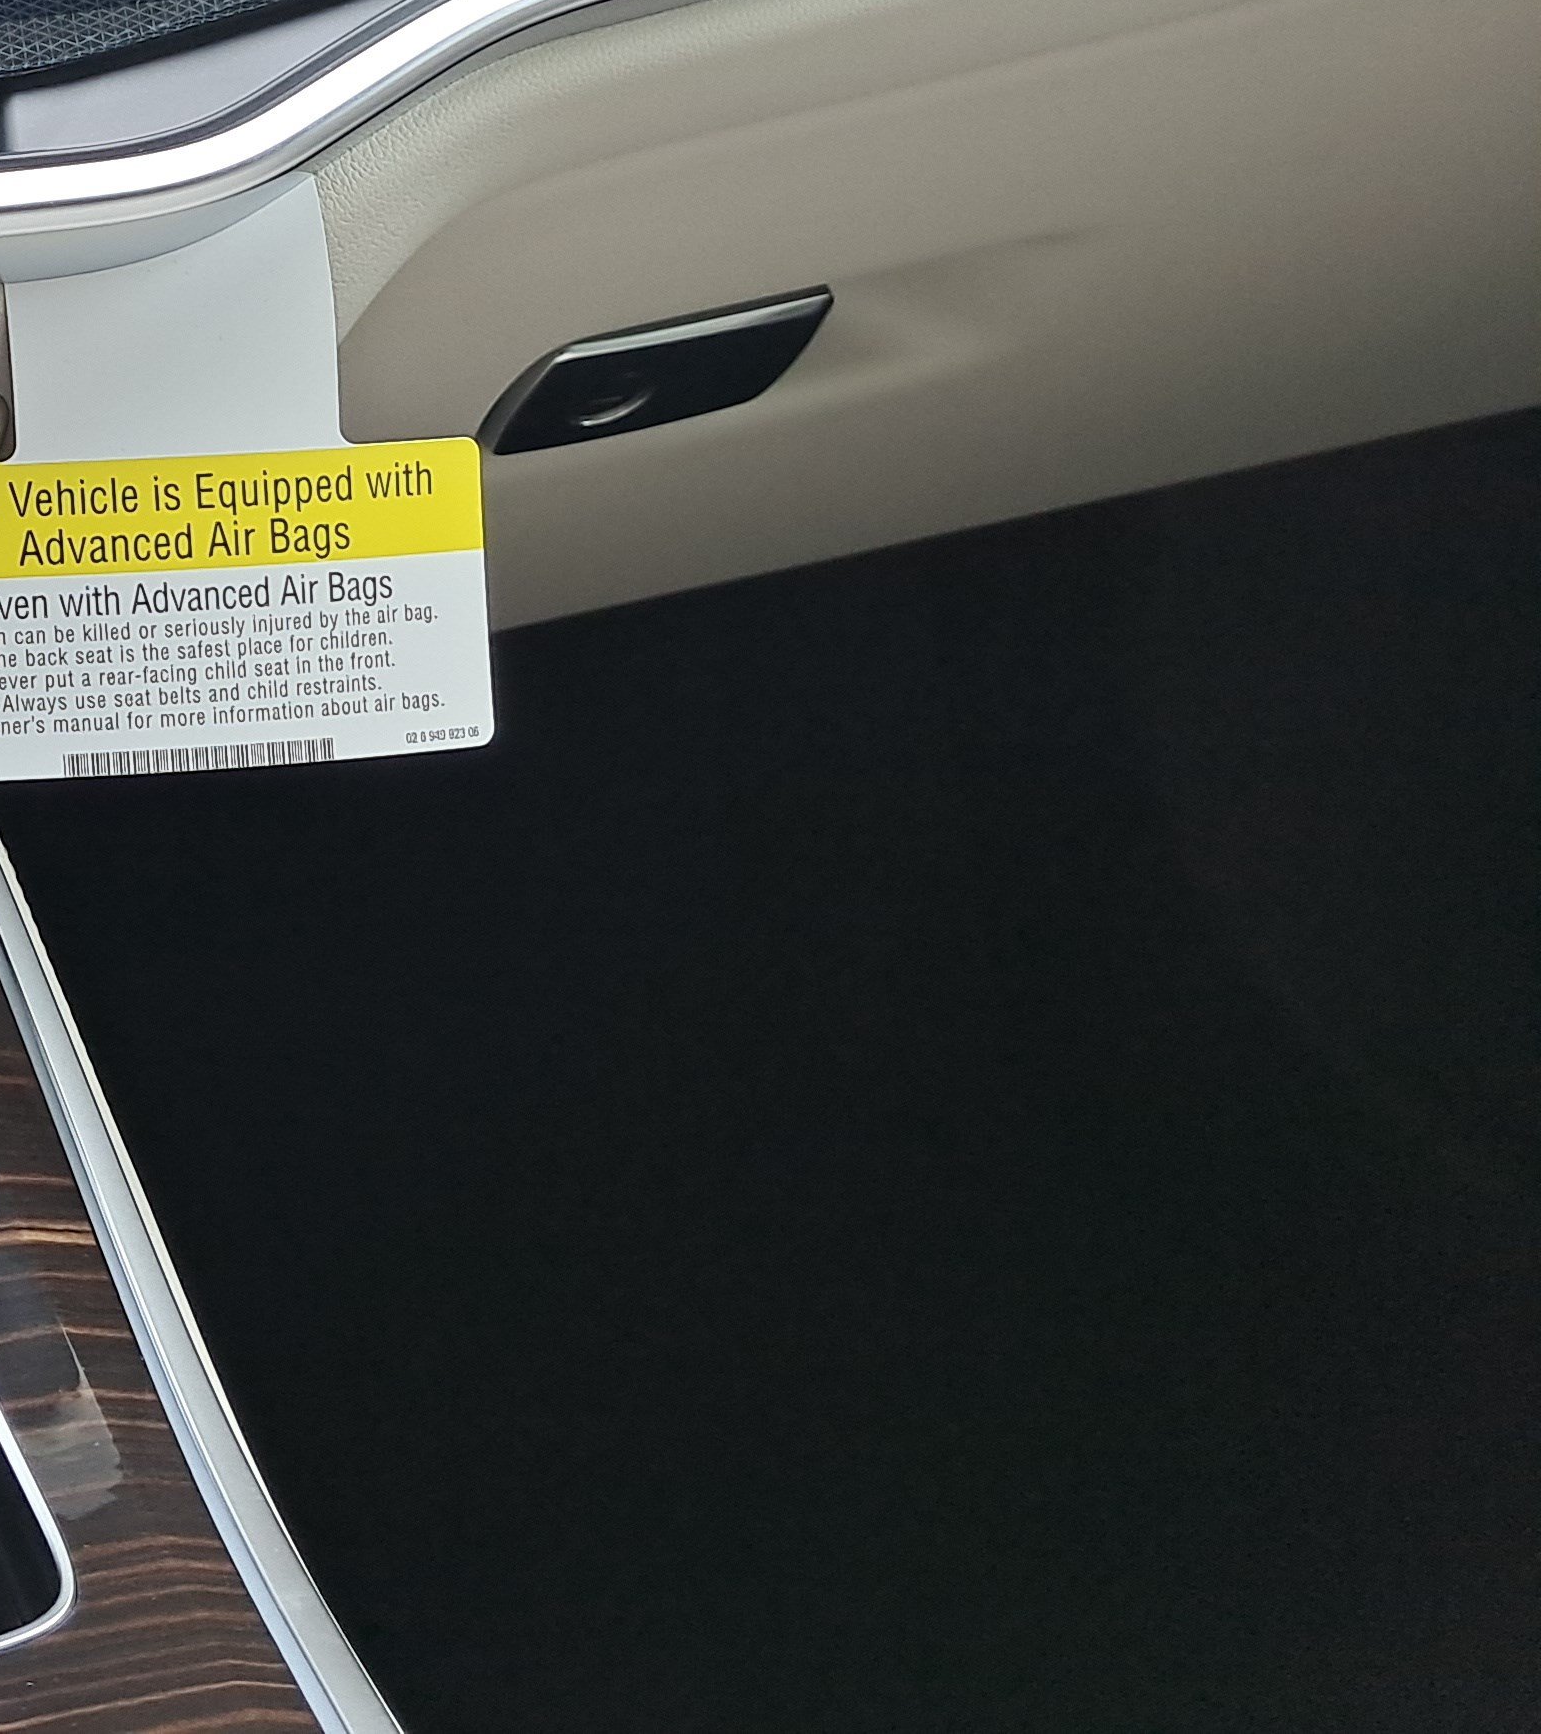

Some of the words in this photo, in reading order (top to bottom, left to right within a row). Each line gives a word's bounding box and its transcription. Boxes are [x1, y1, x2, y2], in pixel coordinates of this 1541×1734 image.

[9, 478, 139, 518] Vehicle
[152, 475, 182, 512] is
[195, 465, 353, 515] Equipped
[365, 460, 434, 499] with
[19, 523, 193, 567] Advanced
[207, 520, 256, 557] Air
[270, 517, 351, 559] Bags
[58, 582, 120, 618] with
[132, 577, 270, 614] Advanced
[281, 574, 318, 606] Air
[328, 570, 393, 608] Bags
[14, 630, 46, 646] can
[54, 625, 75, 643] be
[82, 622, 131, 642] killed
[138, 624, 157, 640] or
[164, 617, 246, 639] seriously
[252, 611, 312, 636] injured
[319, 611, 339, 631] by
[345, 607, 371, 626] the
[377, 604, 398, 623] air
[404, 604, 438, 626] bag.
[25, 648, 69, 667] back
[75, 646, 113, 665] seat
[120, 645, 135, 663] is
[142, 643, 170, 661] the
[177, 640, 231, 660] safest
[237, 637, 283, 659] place
[290, 635, 314, 653] for
[320, 630, 394, 650] children.
[45, 670, 75, 692] put
[81, 672, 92, 687] a
[99, 663, 197, 686] rear-facing
[205, 660, 247, 680] child
[254, 658, 290, 677] seat
[296, 657, 311, 674] in
[318, 655, 344, 673] the
[351, 651, 396, 670] front.
[2, 694, 68, 715] Always
[75, 694, 106, 709] use
[114, 689, 152, 708] seat
[158, 685, 201, 705] belts
[208, 684, 240, 703] and
[247, 680, 289, 700] child
[296, 674, 382, 697] restraints.
[53, 712, 119, 733] manual
[127, 711, 153, 729] for
[160, 712, 206, 727] more
[213, 702, 315, 725] information
[321, 697, 368, 717] about
[374, 694, 396, 713] air
[402, 691, 446, 712] bags.
